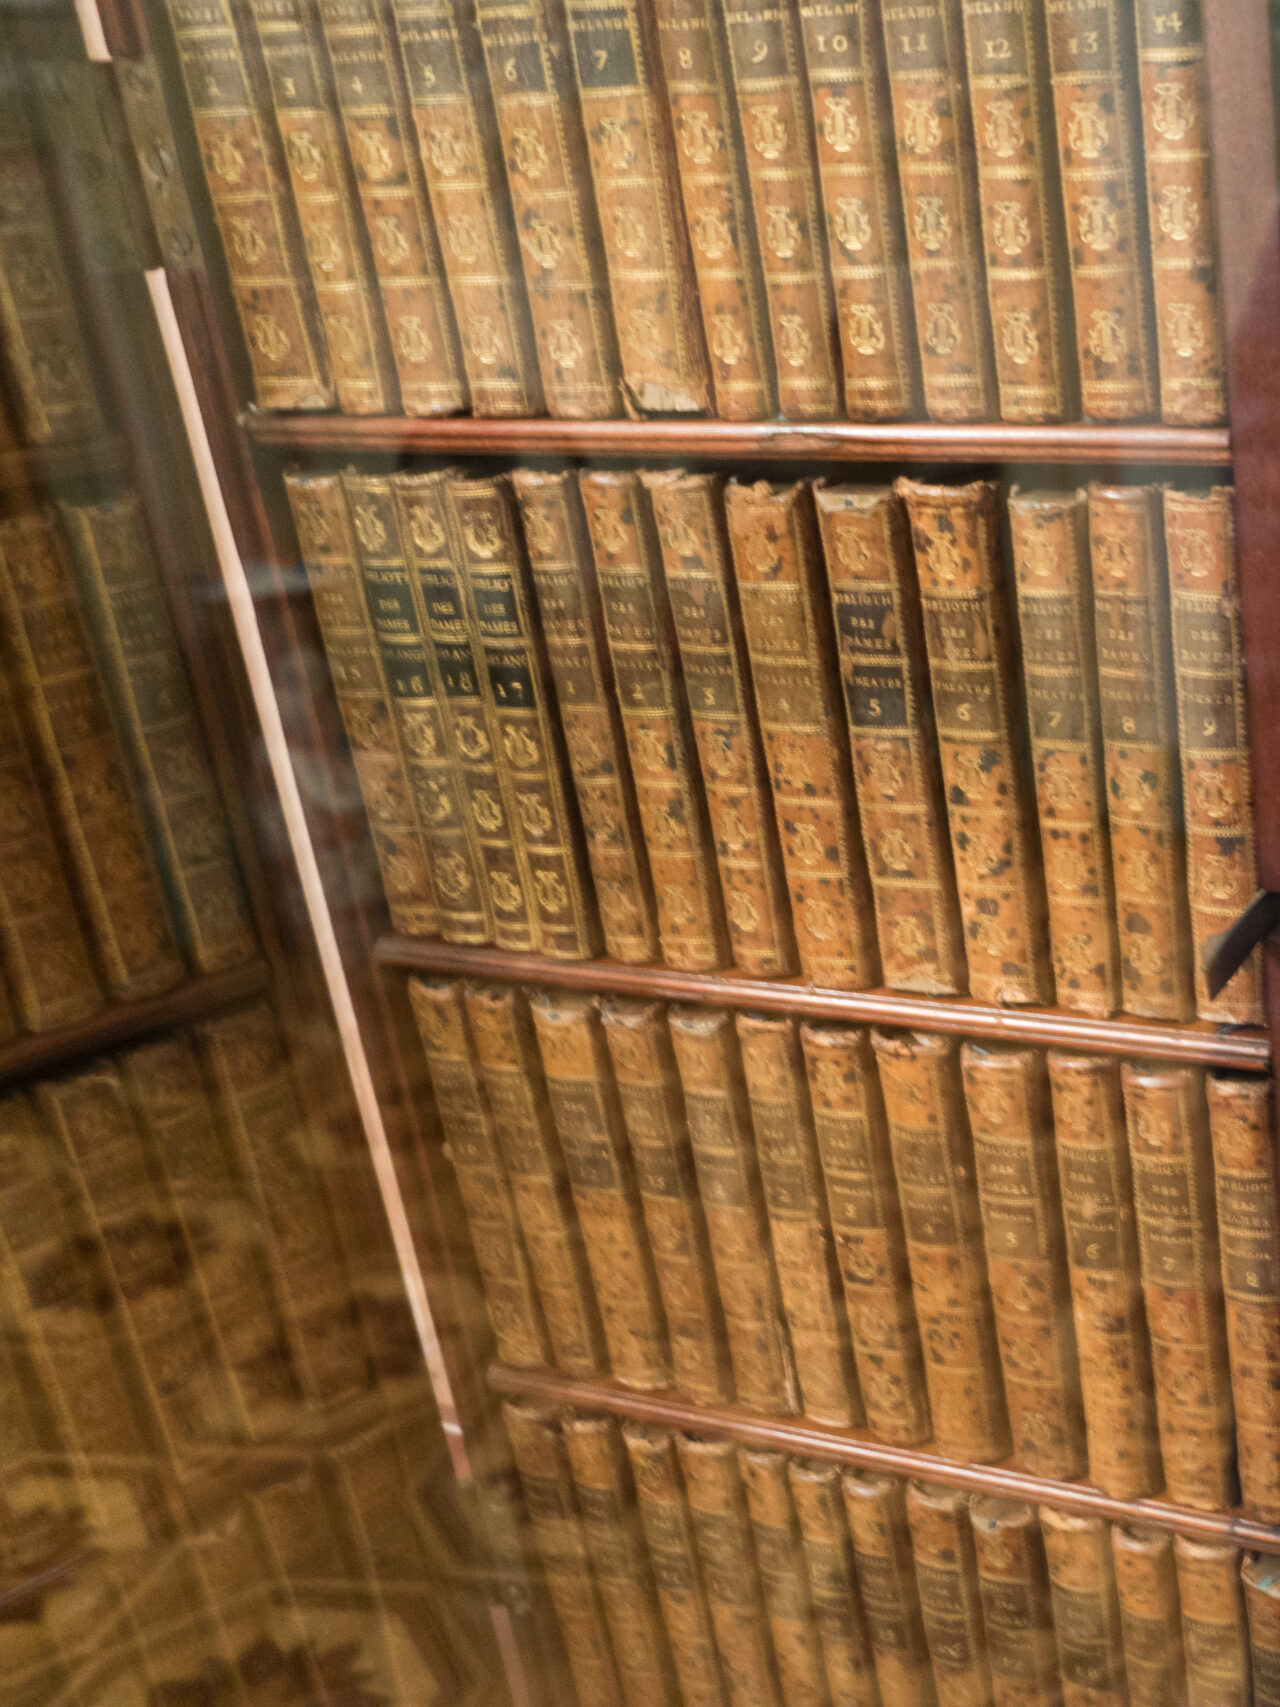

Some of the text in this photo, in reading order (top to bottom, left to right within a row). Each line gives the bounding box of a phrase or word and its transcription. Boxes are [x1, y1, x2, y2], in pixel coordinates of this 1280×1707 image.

[1153, 11, 1183, 34] 14
[751, 39, 769, 64] 9
[815, 34, 848, 53] 10
[899, 33, 929, 54] 11
[984, 38, 1013, 59] 12
[1068, 31, 1099, 55] 13
[593, 50, 608, 72] 7
[677, 47, 693, 70] 8
[503, 57, 518, 82] 6
[631, 683, 645, 701] 2
[701, 686, 716, 705] 3
[867, 698, 882, 718] 5
[956, 703, 972, 722] 6
[1046, 711, 1063, 729] 7
[1120, 716, 1137, 735] 8
[1202, 717, 1218, 737] 9
